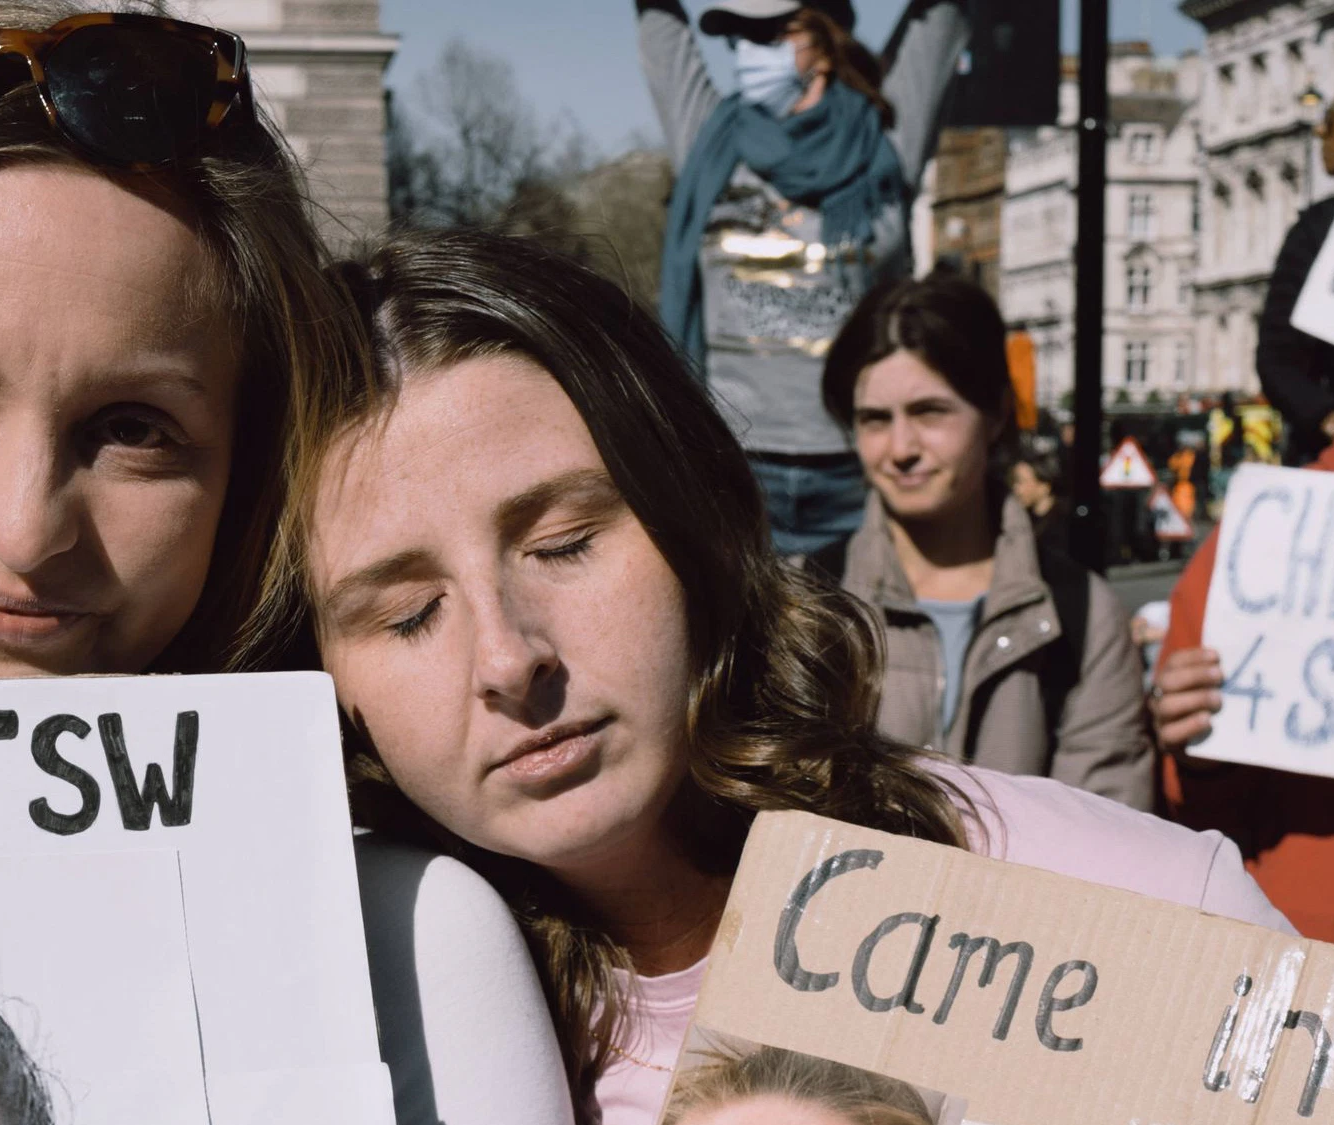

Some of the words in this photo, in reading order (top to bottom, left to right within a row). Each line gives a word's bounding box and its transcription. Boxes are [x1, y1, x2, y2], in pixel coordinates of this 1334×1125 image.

[1222, 634, 1275, 731] 4
[773, 848, 1099, 1053] Came
[1203, 975, 1333, 1118] in
